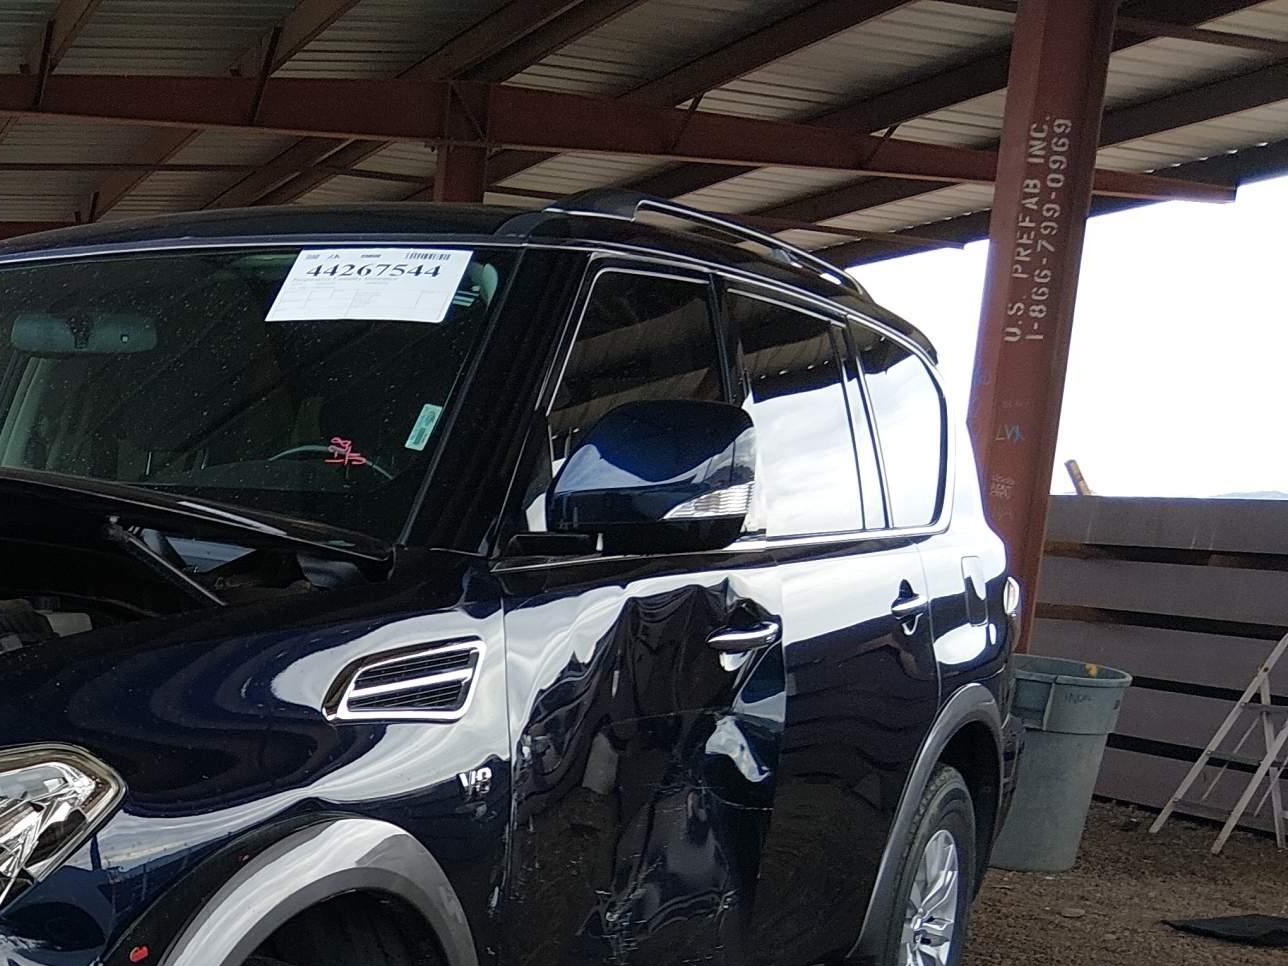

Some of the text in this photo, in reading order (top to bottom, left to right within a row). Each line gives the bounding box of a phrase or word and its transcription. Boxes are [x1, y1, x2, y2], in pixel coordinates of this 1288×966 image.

[305, 263, 441, 278] 44267544
[1004, 116, 1050, 342] U.S. PREFAB INC.
[1025, 118, 1072, 340] 1-866-799-0969
[459, 766, 492, 796] V8
